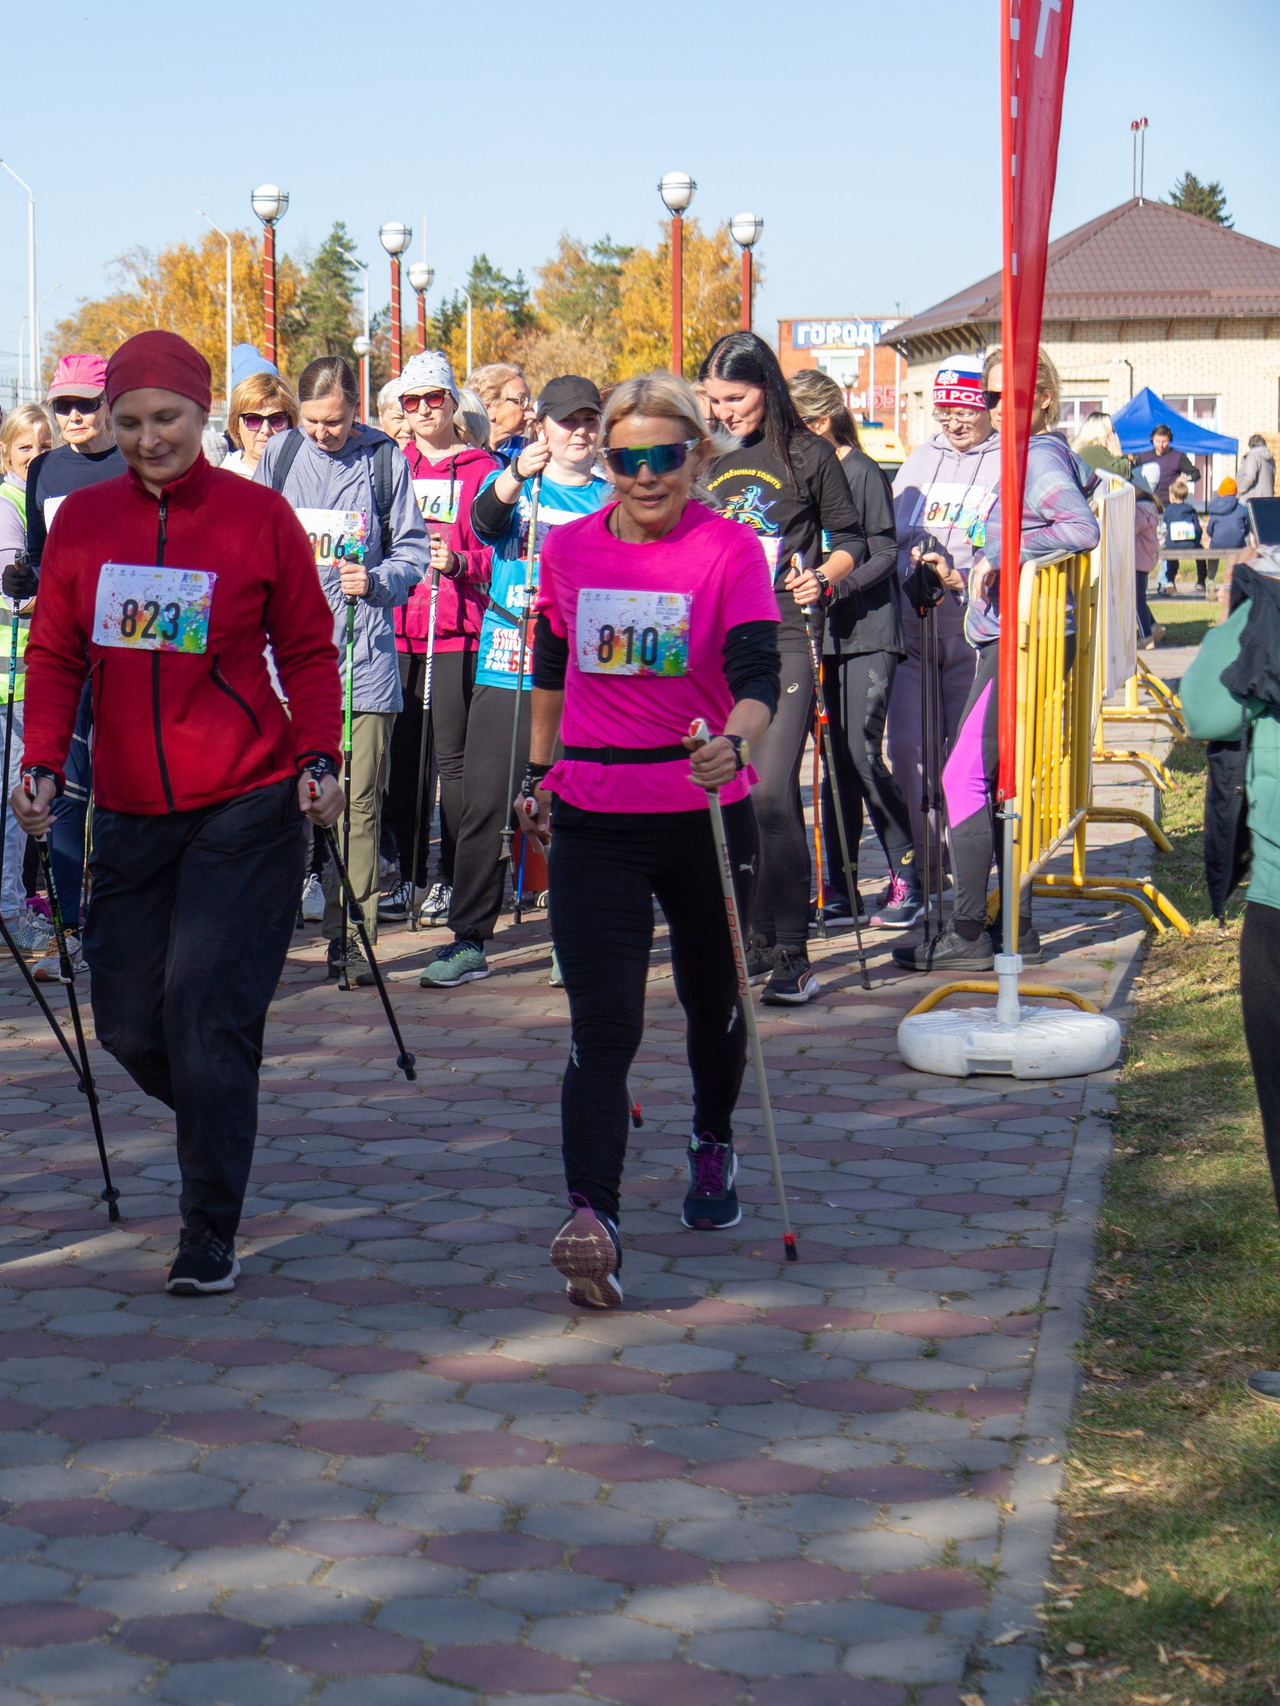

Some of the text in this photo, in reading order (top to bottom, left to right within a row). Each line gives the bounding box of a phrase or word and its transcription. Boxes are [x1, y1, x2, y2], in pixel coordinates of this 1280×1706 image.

[797, 323, 874, 346] ГОРОД
[121, 598, 181, 640] 823
[597, 624, 659, 666] 810
[724, 896, 749, 996] PASSION
